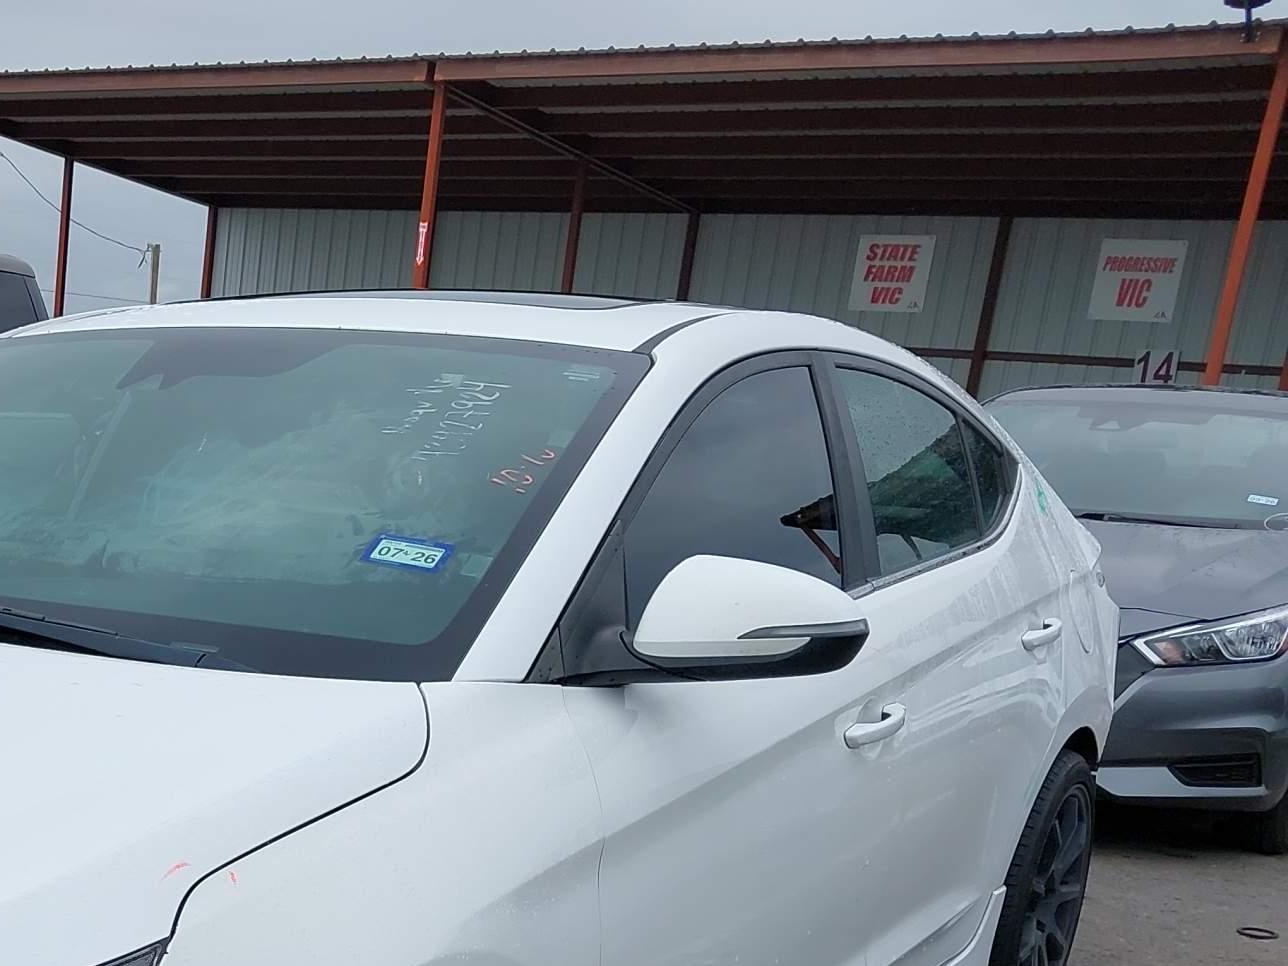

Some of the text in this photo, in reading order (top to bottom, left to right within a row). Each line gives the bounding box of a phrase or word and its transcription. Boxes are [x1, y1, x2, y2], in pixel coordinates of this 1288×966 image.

[866, 243, 922, 262] STATE
[863, 264, 916, 282] FARM
[1102, 255, 1178, 273] PROGRESSIVE
[870, 286, 904, 305] VIC
[1115, 278, 1152, 308] VIC
[1136, 350, 1174, 383] 14
